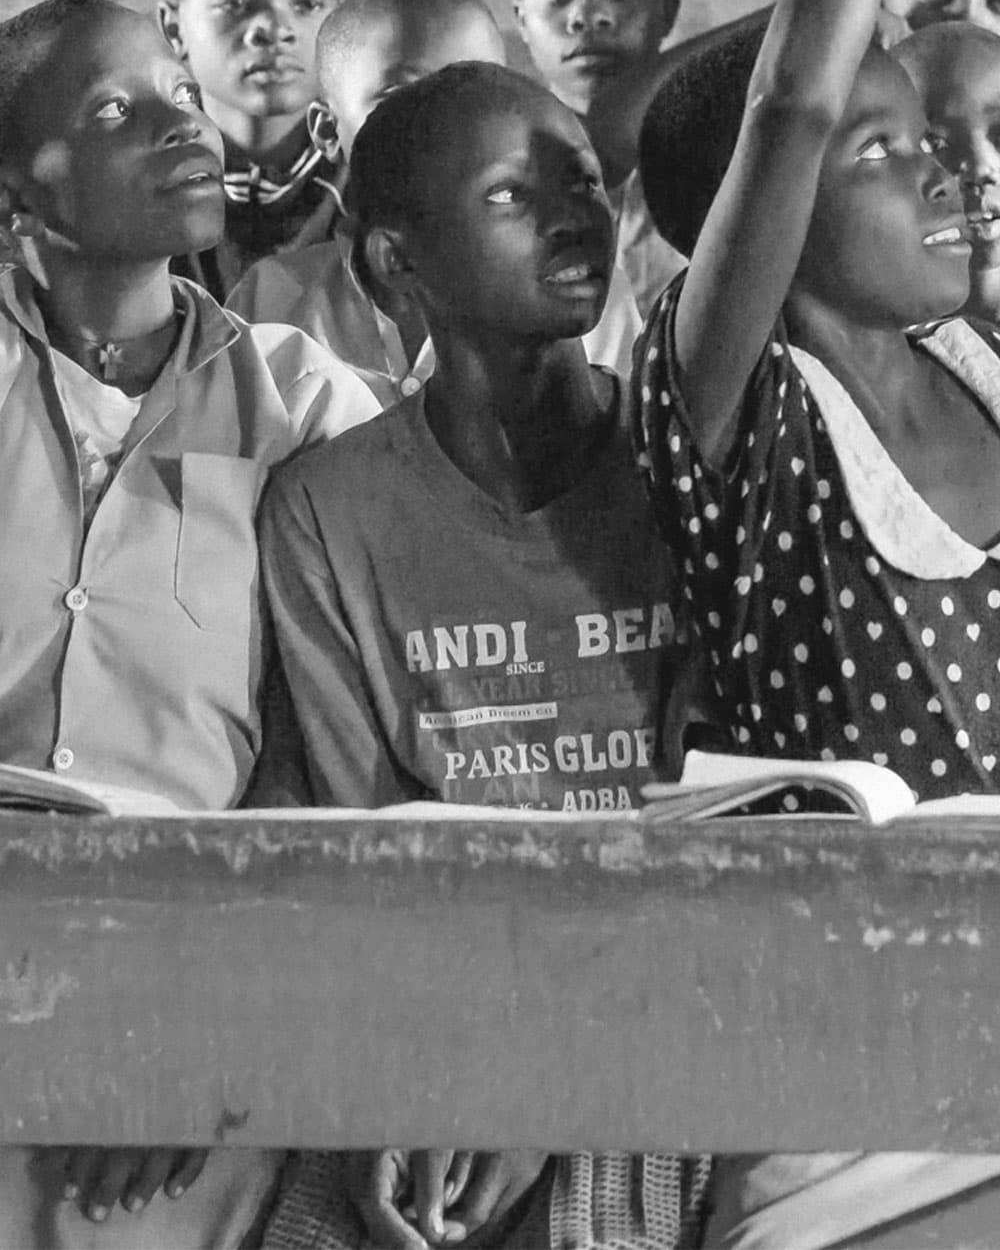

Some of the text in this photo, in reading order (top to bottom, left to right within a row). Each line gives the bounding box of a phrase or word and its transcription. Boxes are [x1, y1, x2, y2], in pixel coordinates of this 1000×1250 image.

[406, 621, 528, 673] ANDI
[506, 661, 545, 675] SINCE
[445, 742, 550, 780] PARIS
